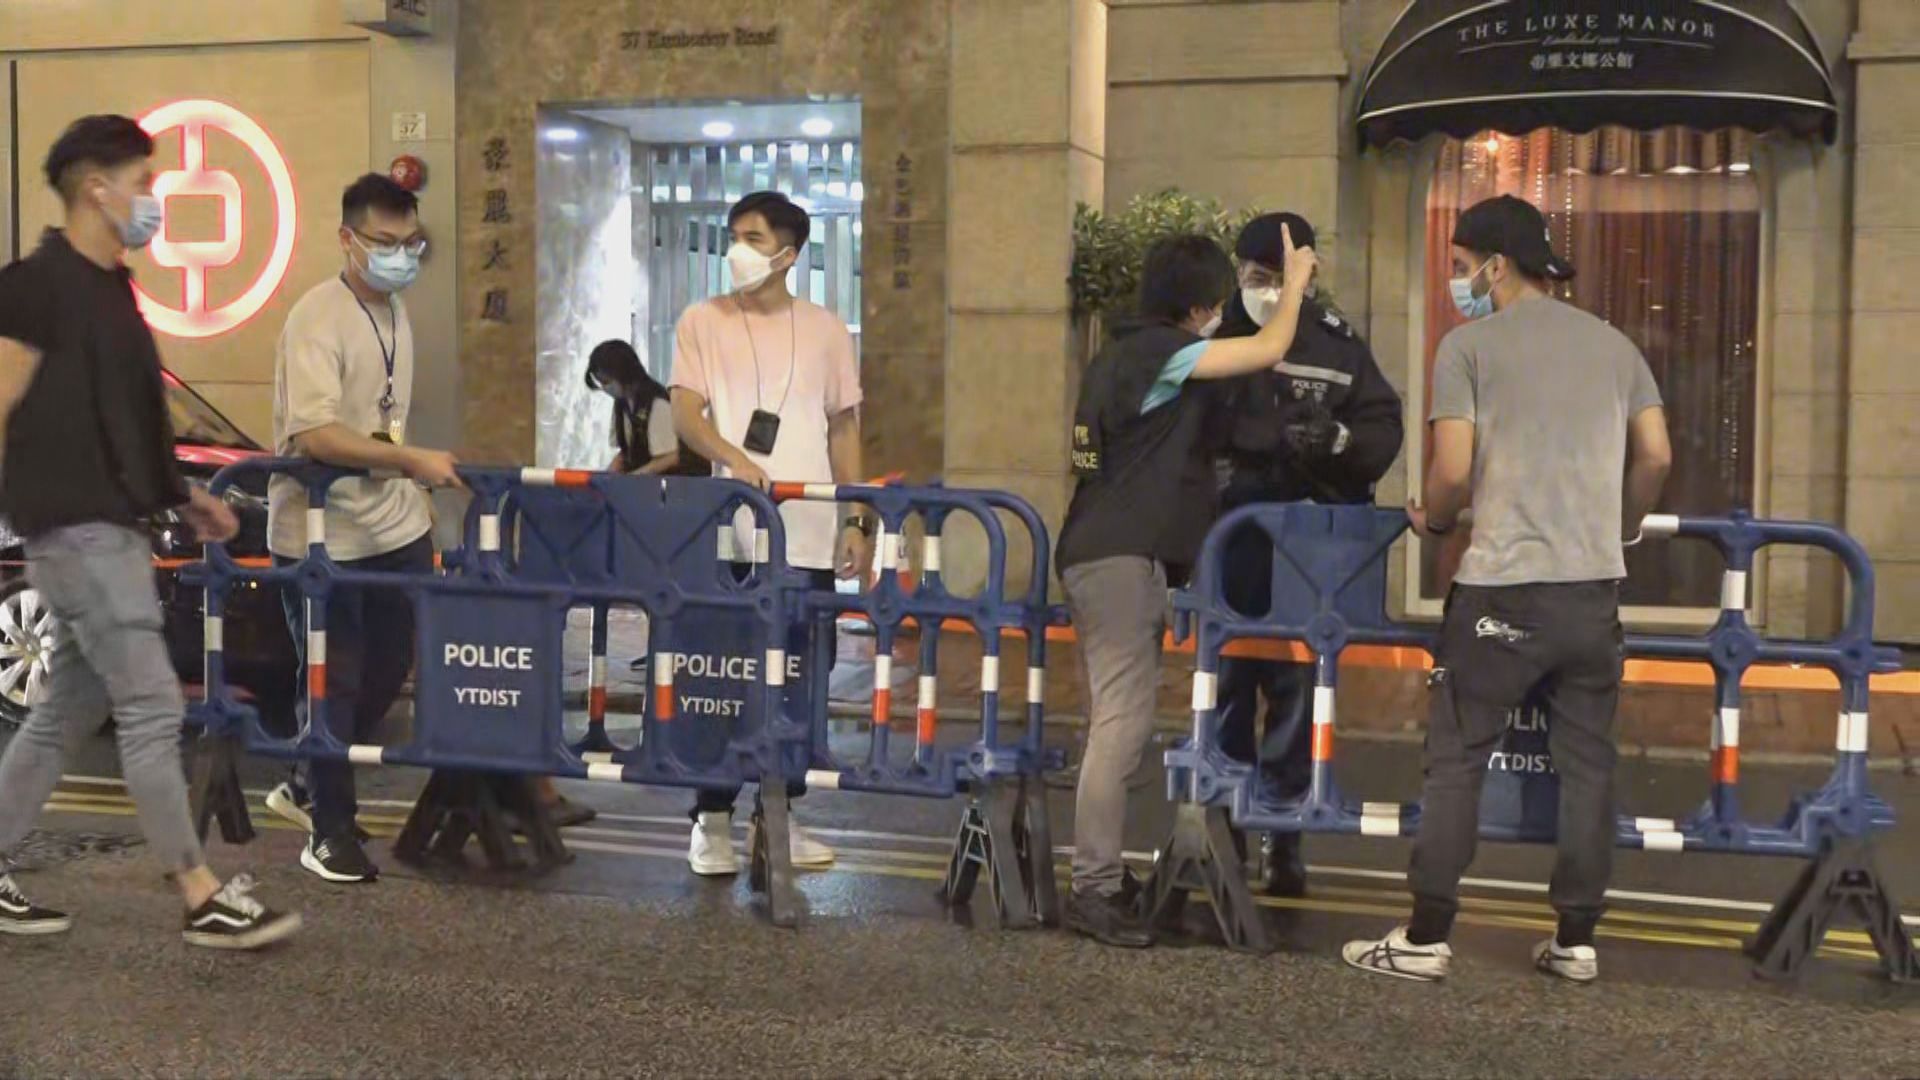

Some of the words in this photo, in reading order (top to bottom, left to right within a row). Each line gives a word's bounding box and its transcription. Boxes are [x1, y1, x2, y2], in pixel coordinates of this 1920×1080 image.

[621, 31, 640, 49] 37
[734, 26, 776, 46] Road
[1457, 20, 1508, 42] THE
[1525, 14, 1599, 32] LUXE
[1616, 13, 1715, 38] MANOR
[399, 121, 417, 134] 37
[1291, 378, 1328, 392] POLICE
[444, 643, 533, 670] POLICE
[673, 653, 758, 681] POLICE
[454, 687, 521, 707] YTDIST
[680, 695, 744, 717] YTDIST
[1487, 752, 1554, 773] YTDIS
